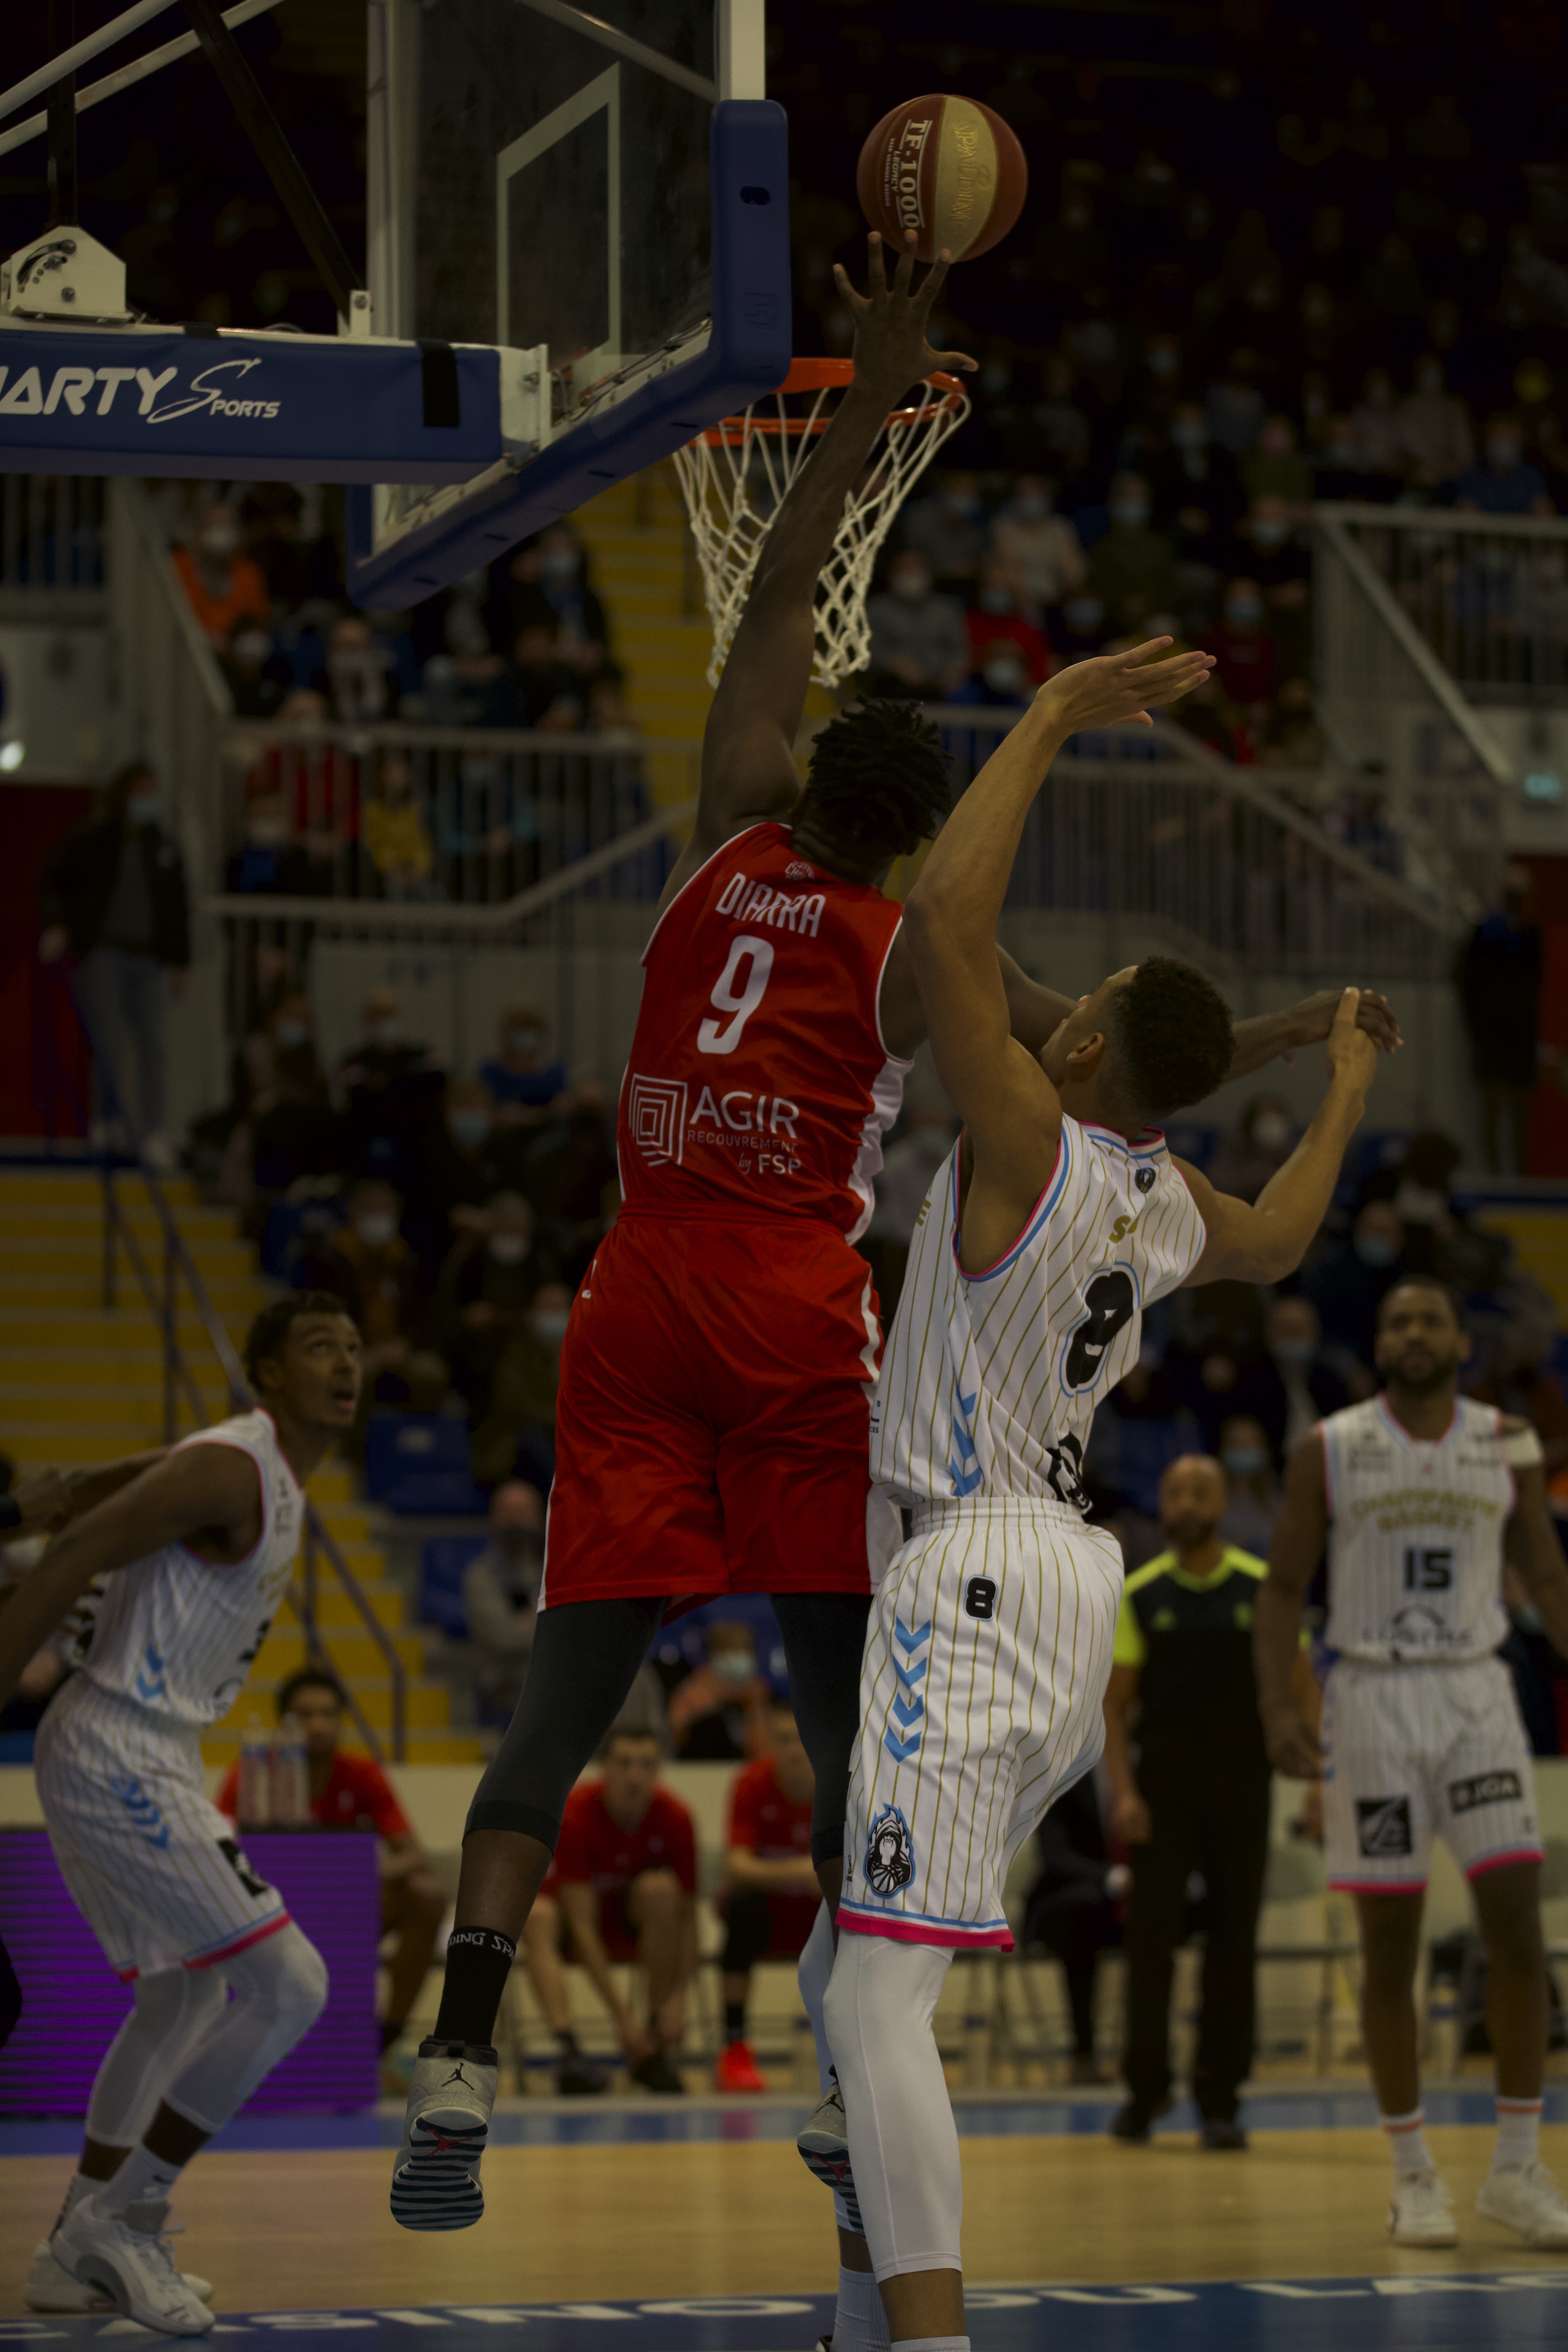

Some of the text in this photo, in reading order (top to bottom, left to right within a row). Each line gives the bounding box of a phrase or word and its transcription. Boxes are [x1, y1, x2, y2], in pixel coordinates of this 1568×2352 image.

[891, 151, 901, 192] LEGACY
[900, 120, 928, 228] TF-1000
[146, 358, 281, 424] SPORTS
[715, 871, 826, 938] DIARRA
[697, 934, 775, 1055] 9
[689, 1085, 800, 1139] AGIR
[687, 1129, 799, 1153] RECOUVREMENT
[738, 1152, 802, 1175] by FSP
[1065, 1269, 1135, 1390] 8
[1405, 1548, 1451, 1589] 15
[965, 1576, 996, 1619] 8
